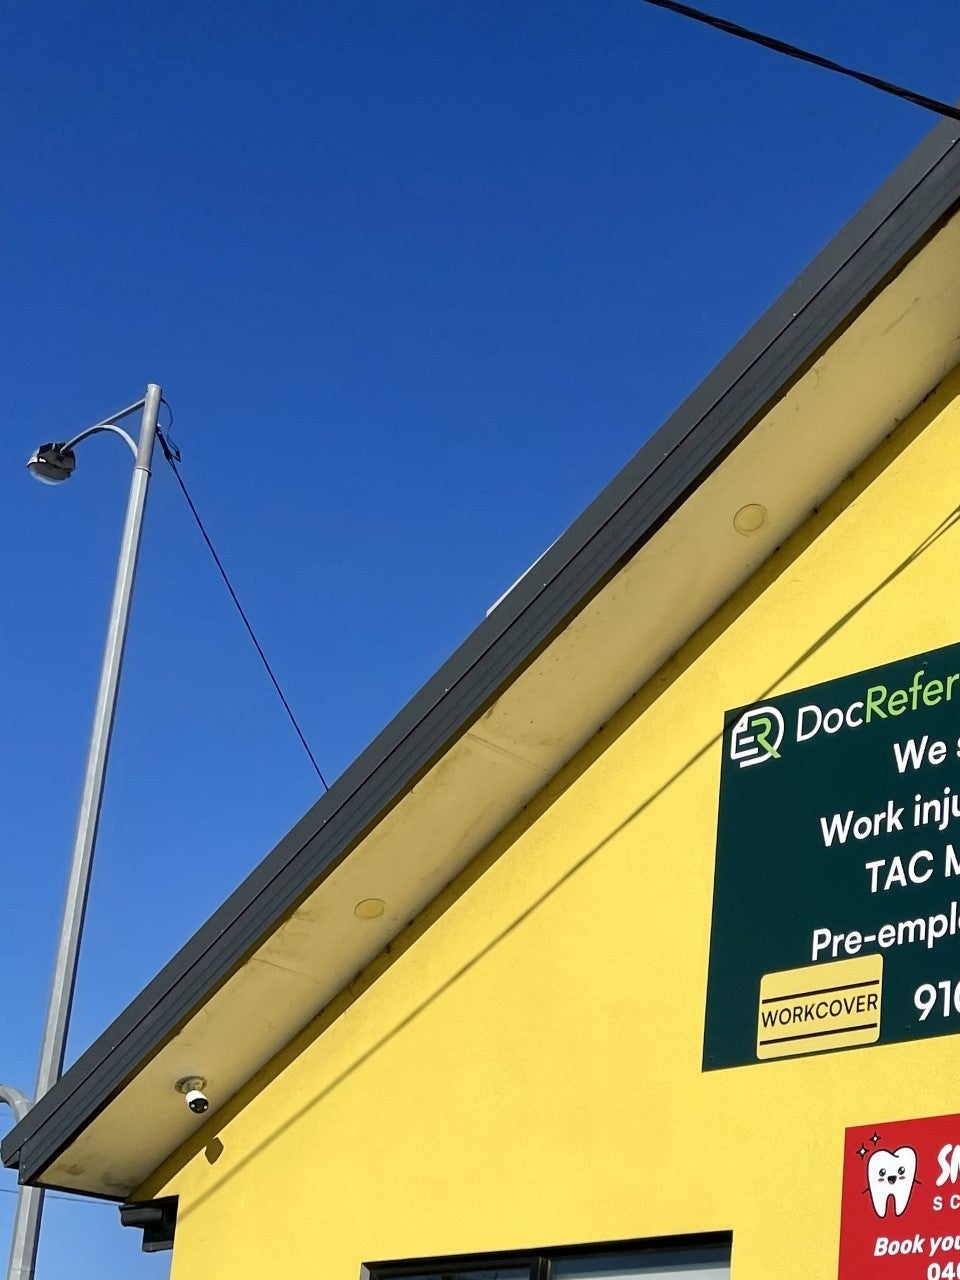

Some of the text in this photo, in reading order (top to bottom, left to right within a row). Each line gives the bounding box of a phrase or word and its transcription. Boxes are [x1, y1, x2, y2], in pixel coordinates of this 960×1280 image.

[893, 734, 947, 774] We
[819, 800, 905, 848] Work
[865, 849, 934, 894] TAC
[761, 993, 879, 1028] WORKCOVER
[873, 1233, 926, 1257] Book
